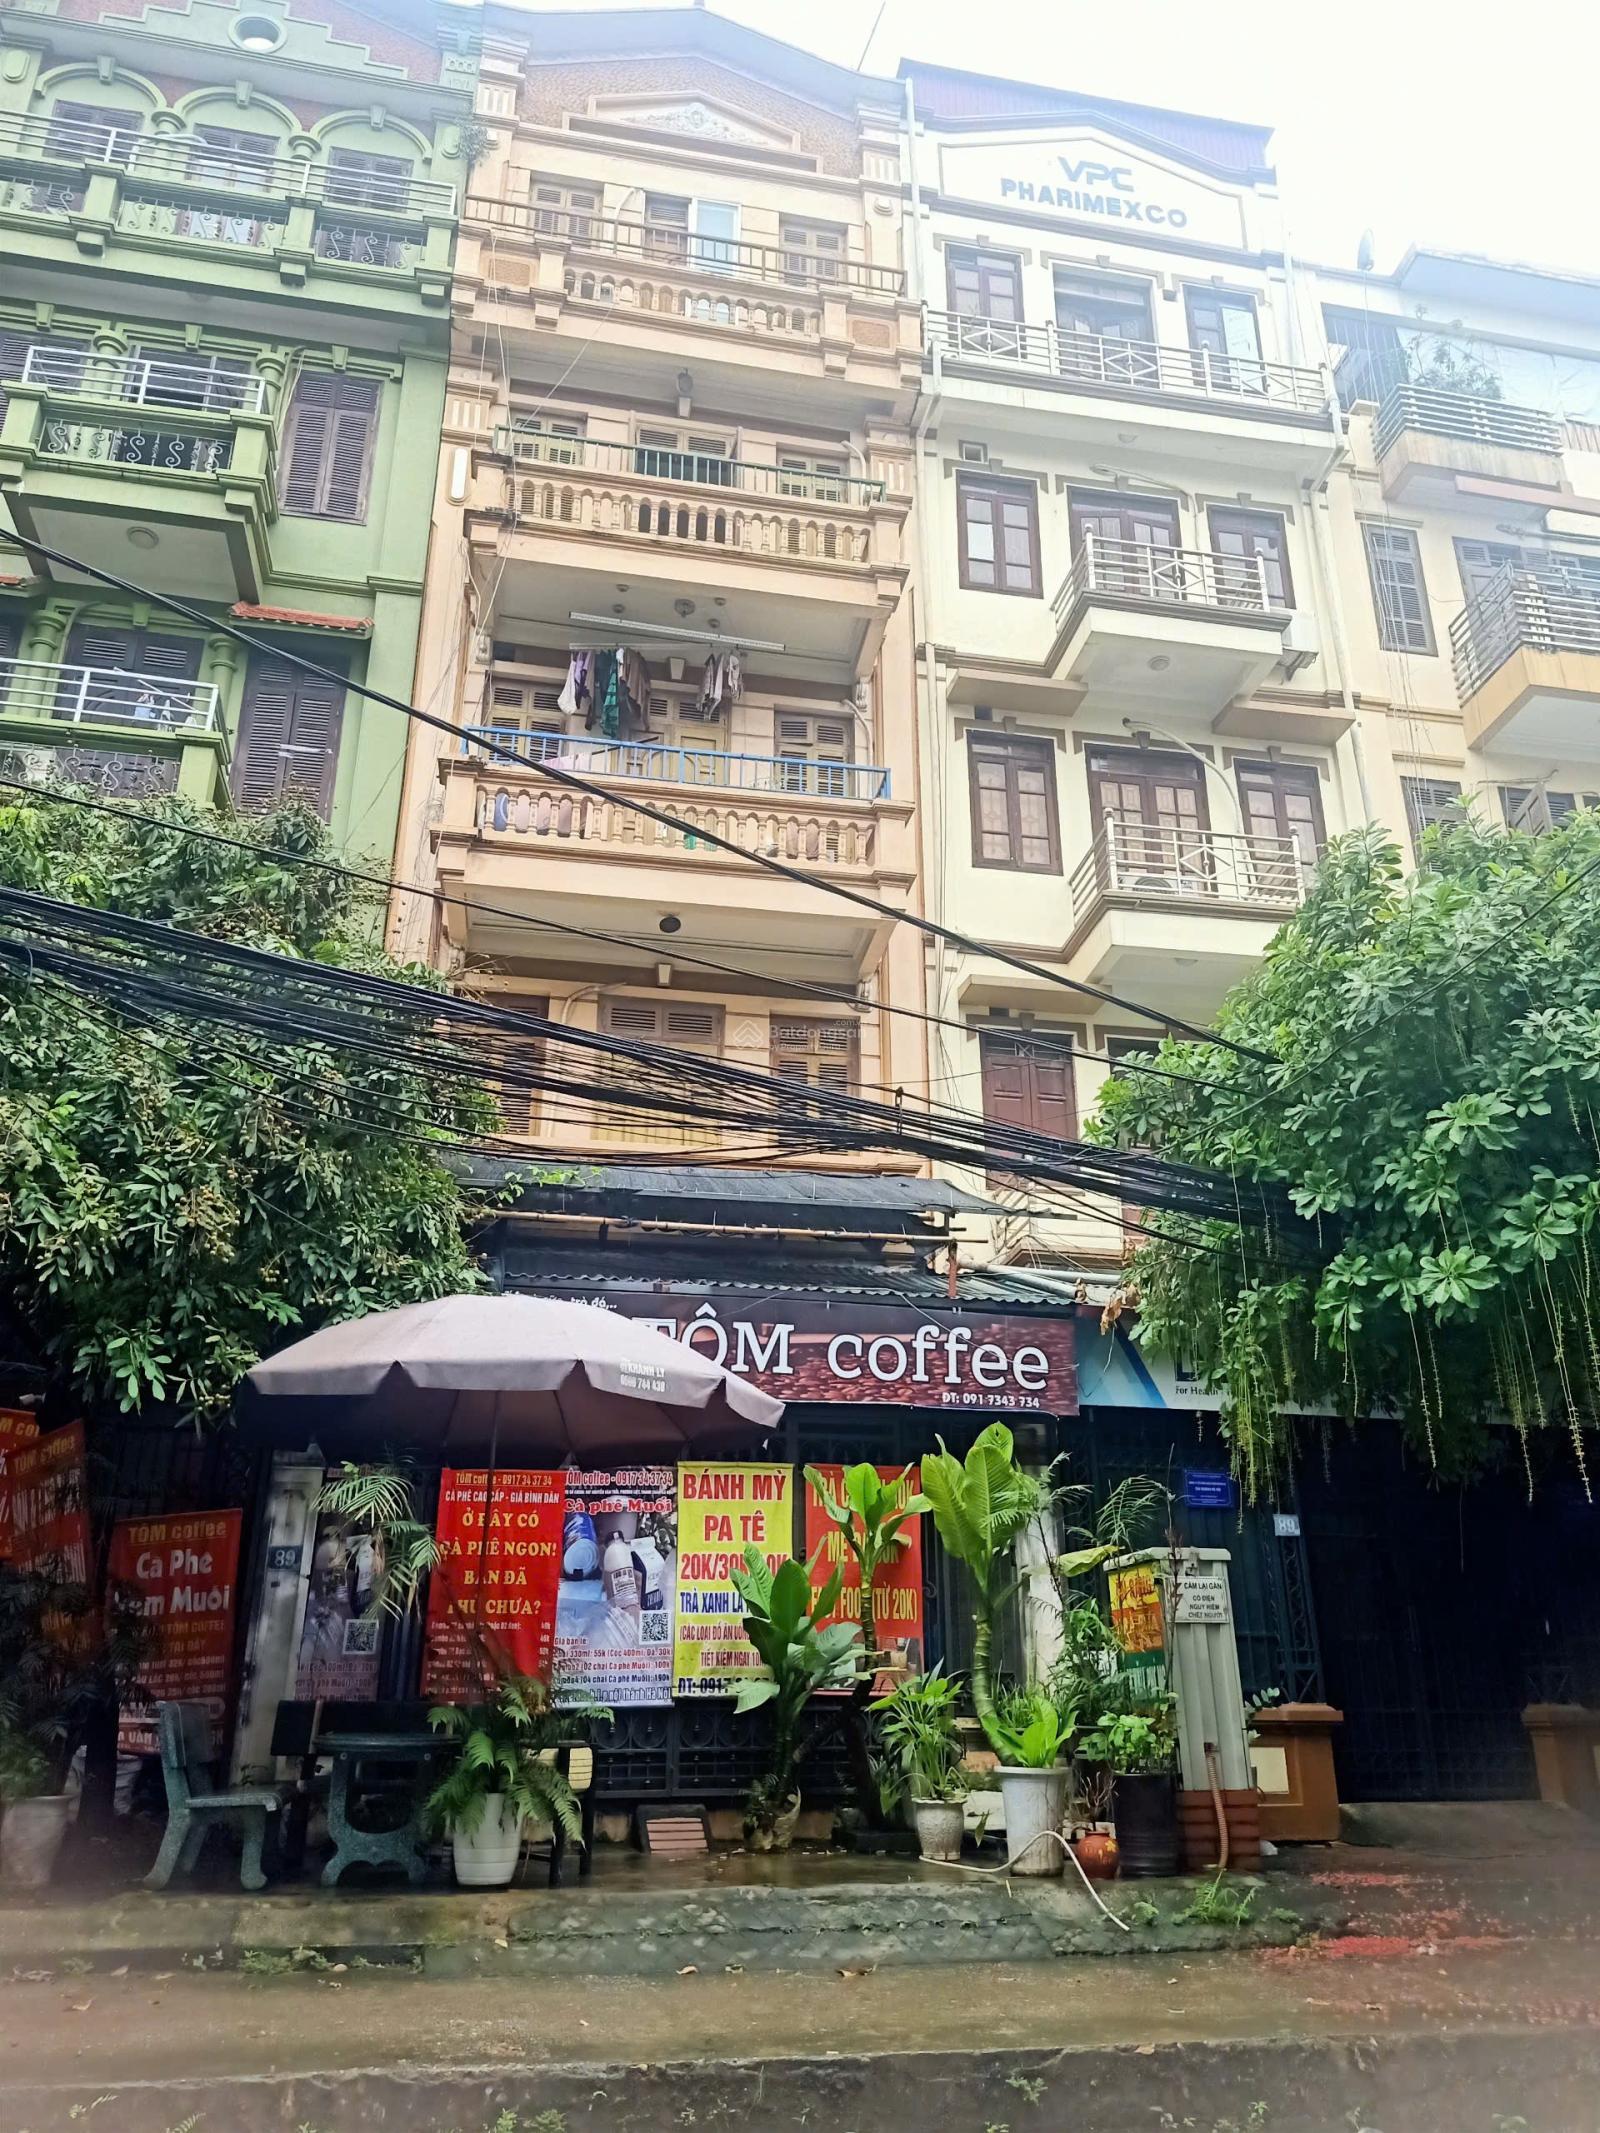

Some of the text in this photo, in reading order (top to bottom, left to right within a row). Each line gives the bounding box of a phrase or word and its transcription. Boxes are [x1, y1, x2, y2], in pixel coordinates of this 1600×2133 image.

[1057, 155, 1134, 192] VPC
[1000, 177, 1188, 228] PHARIMEXCO
[827, 1325, 1049, 1390] coffee
[962, 1393, 983, 1405] 091
[987, 1395, 1016, 1407] 7343
[1018, 1396, 1040, 1408] 734
[1191, 1385, 1218, 1396] Heh
[473, 1474, 497, 1485] coffe
[502, 1474, 520, 1486] 0917
[521, 1475, 531, 1486] 34
[532, 1475, 542, 1486] 37
[543, 1475, 552, 1487] 34
[565, 1467, 583, 1487] ÔM
[582, 1469, 611, 1486] coffee
[615, 1471, 637, 1486] 0917
[683, 1468, 787, 1501] BÁNH MỲ
[445, 1490, 456, 1502] CÀ
[457, 1488, 472, 1502] PHÊ
[510, 1489, 523, 1503] GIÁ
[524, 1489, 542, 1504] BÌNH
[564, 1496, 672, 1515] Cà phê Muối
[462, 1506, 475, 1527] Ở
[517, 1510, 540, 1528] CÓ
[704, 1510, 765, 1542] PA TÊ
[1278, 1518, 1296, 1533] 89
[128, 1520, 228, 1544] TÔM coffee
[274, 1549, 296, 1567] 89
[503, 1541, 557, 1556] NGON!
[503, 1566, 528, 1585] ĐÃ
[485, 1597, 542, 1615] CHƯA?
[680, 1588, 699, 1613] TRÀ
[702, 1592, 729, 1613] XANH
[840, 1586, 863, 1619] FOO
[872, 1581, 891, 1622] (TỪ
[892, 1587, 917, 1623] 20K)
[715, 1648, 733, 1669] KIỆM
[734, 1651, 750, 1667] NGAY
[752, 1652, 766, 1667] 10
